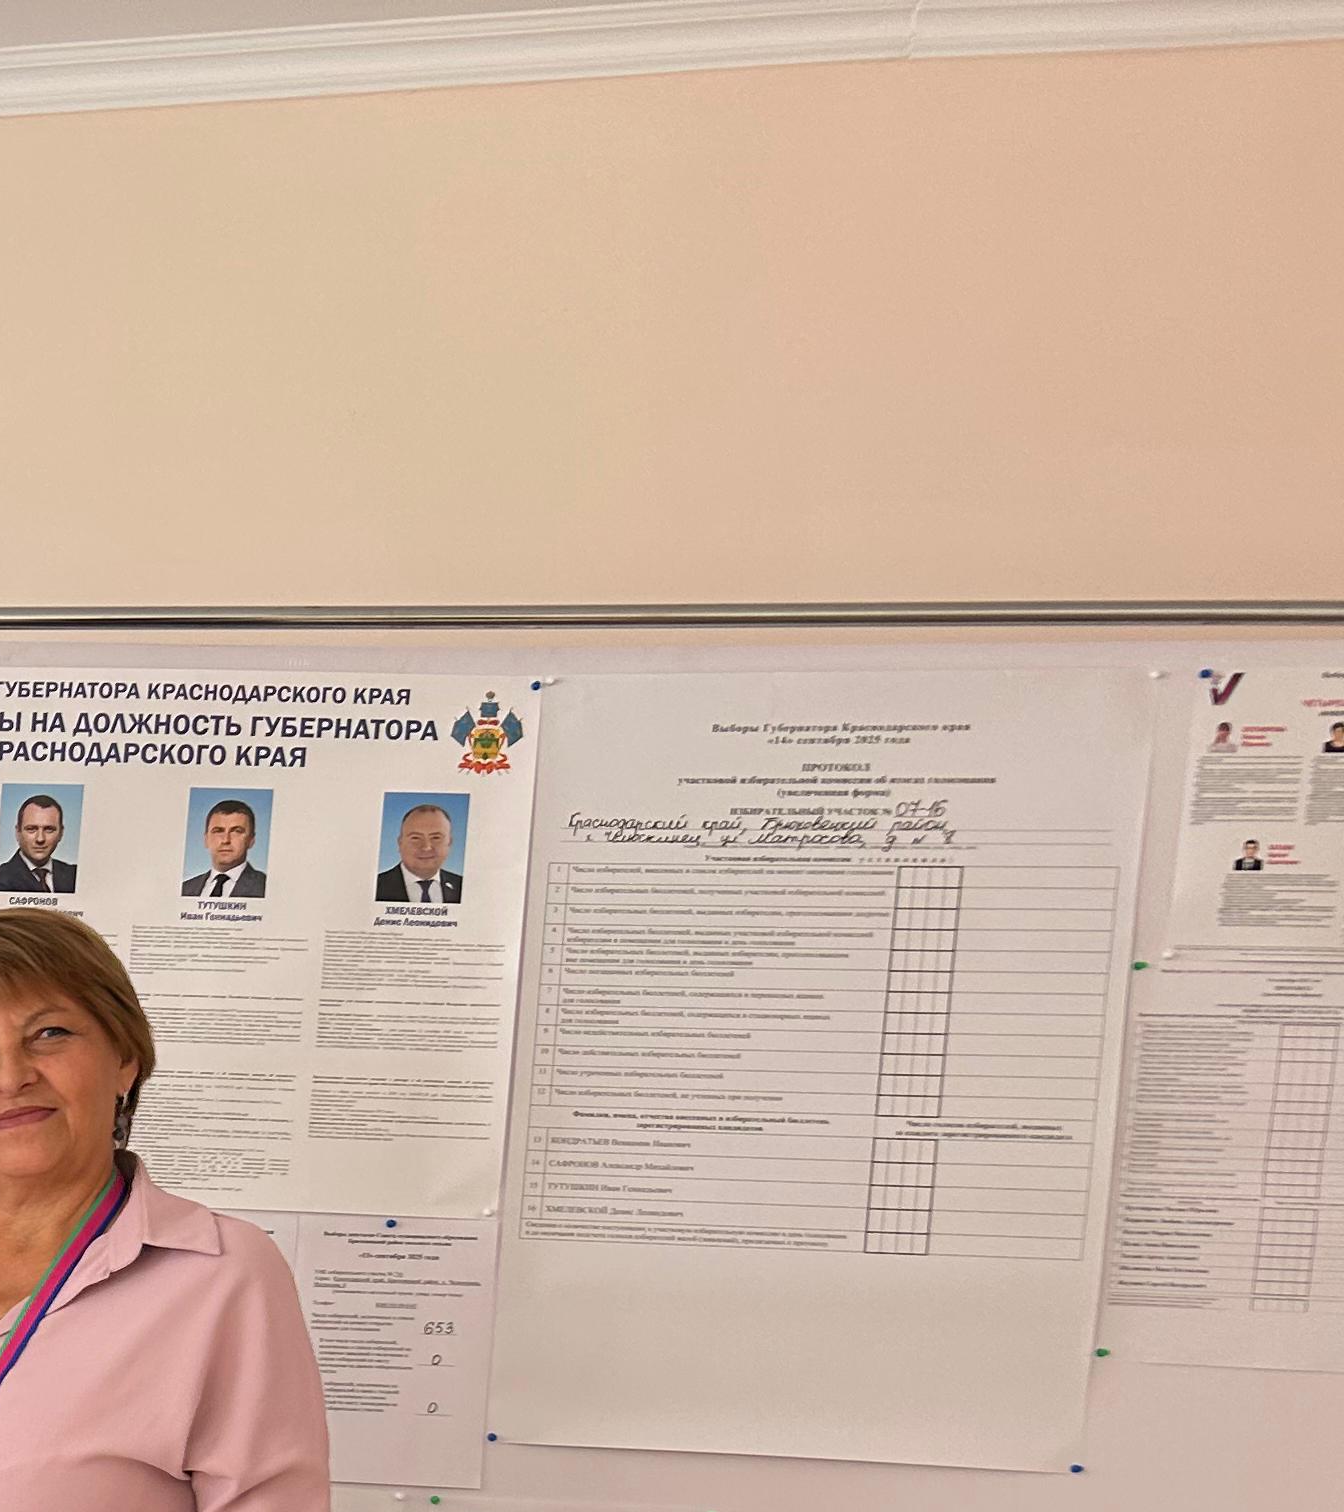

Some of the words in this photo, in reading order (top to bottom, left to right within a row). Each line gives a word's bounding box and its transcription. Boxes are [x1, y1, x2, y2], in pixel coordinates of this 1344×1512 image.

[147, 683, 346, 705] КРАСНОДАРСКОГО
[353, 687, 411, 705] КРАЯ
[30, 712, 66, 733] НА
[73, 713, 242, 736] ДОЛЖНОСТЬ
[250, 716, 439, 741] ГУБЕРНАТОРА
[234, 746, 307, 767] КРАЯ
[423, 1321, 454, 1335] 653
